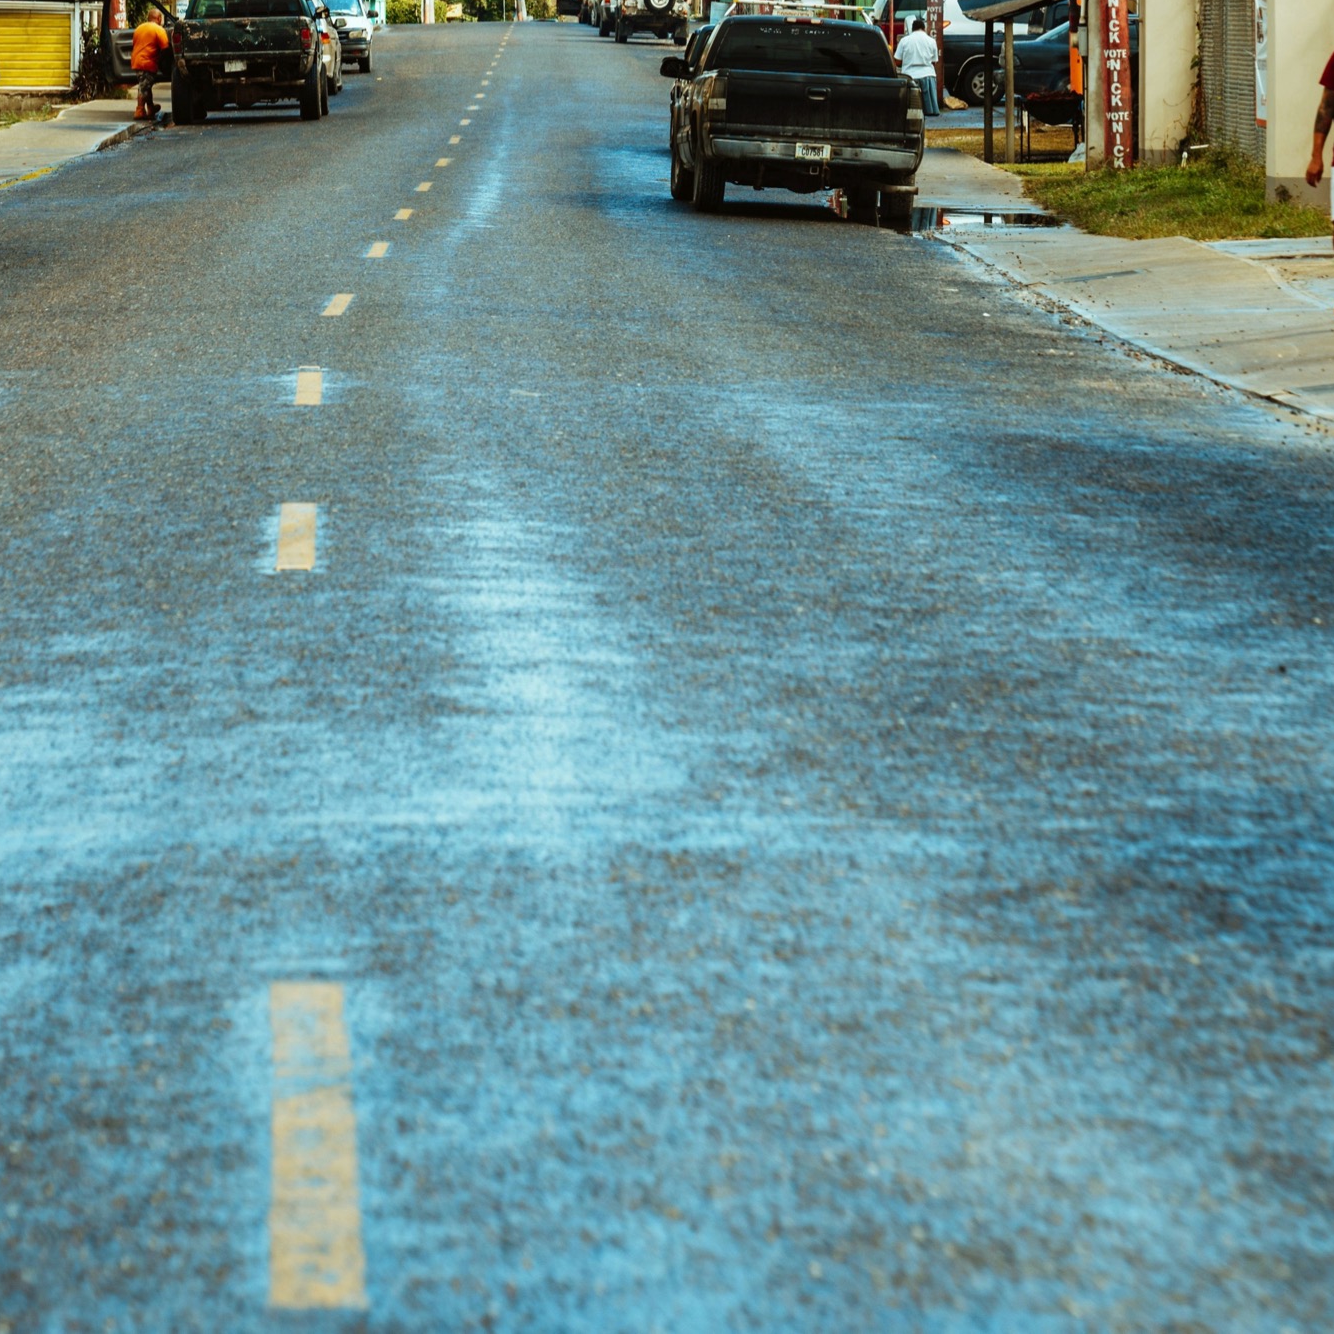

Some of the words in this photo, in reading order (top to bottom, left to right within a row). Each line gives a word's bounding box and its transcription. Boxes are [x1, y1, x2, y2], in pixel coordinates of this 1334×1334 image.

[930, 13, 938, 38] NIC
[1104, 49, 1127, 59] VOTE
[1110, 59, 1123, 107] NICK
[1106, 112, 1130, 121] VOTE
[1112, 122, 1125, 169] NICK
